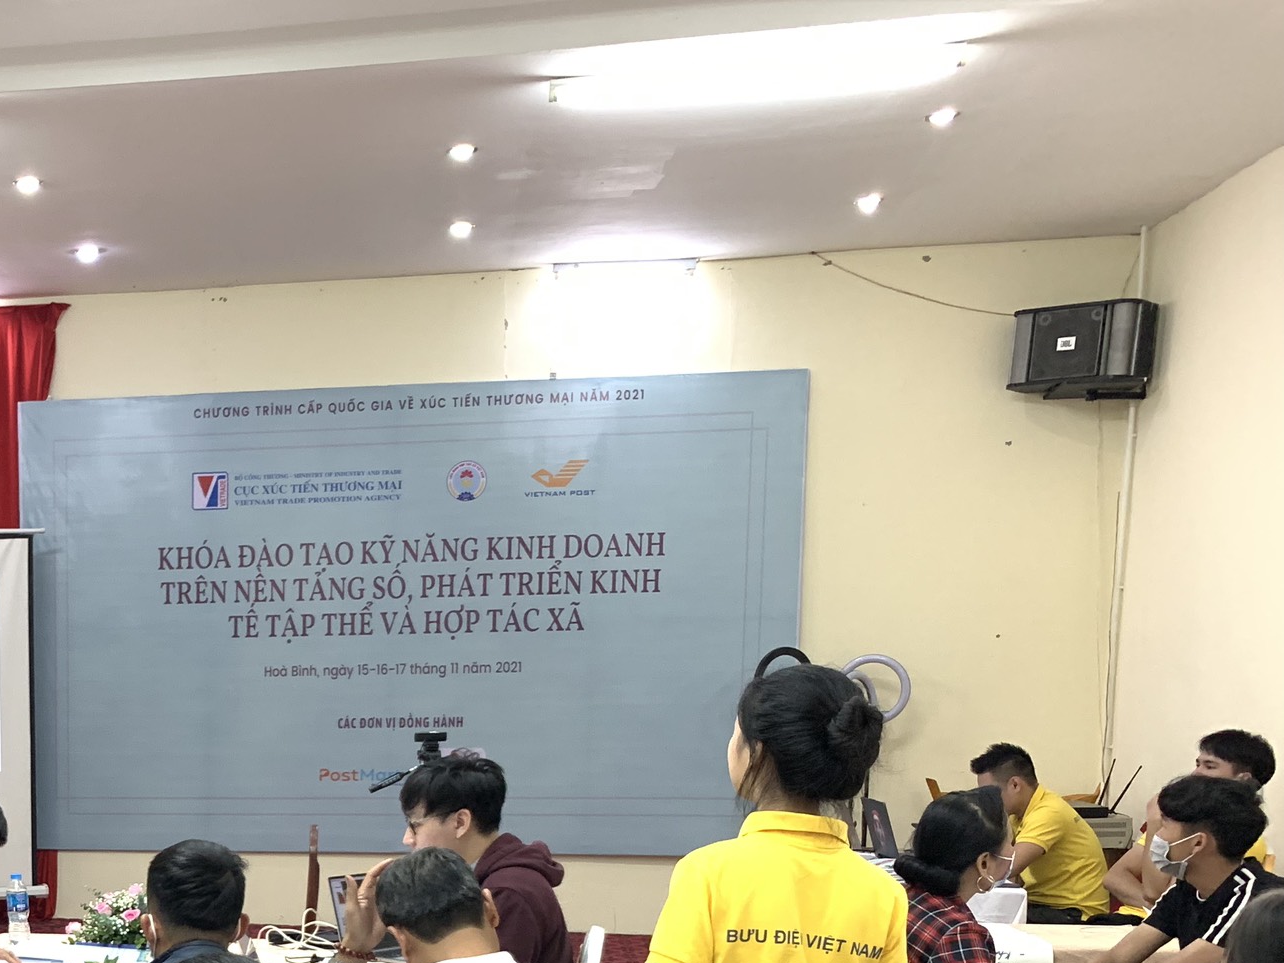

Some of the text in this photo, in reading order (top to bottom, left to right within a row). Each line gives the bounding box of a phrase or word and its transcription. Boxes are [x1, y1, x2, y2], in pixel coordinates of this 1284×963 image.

[194, 388, 645, 419] CHƯƠNG TRÌNH CẤP QUỐC GIA VỀ XÚC TIẾN THƯƠNG MẠI NĂM 2021
[234, 479, 402, 498] CỤC XÚC TIẾN THƯƠNG MẠI
[308, 496, 362, 504] PROMOTION
[524, 490, 566, 498] VIETNAM
[158, 532, 666, 572] KHÓA ĐÀO TẠO KỸ NĂNG KINH DOANH
[160, 560, 661, 605] TRÊN NỀN TẢNG SỐ, PHÁT TRIỂN KINH
[228, 601, 584, 644] TẾ TẬP THỂ VÀ HỢP TÁC XÃ
[264, 661, 522, 680] Hoà Bình, ngày 15-16-17 tháng 11 năm 2021
[338, 713, 464, 731] CÁC ĐƠN VỊ ĐỒNG HÀNH
[726, 929, 884, 960] BƯU ĐIỆ VIỆT NAM
